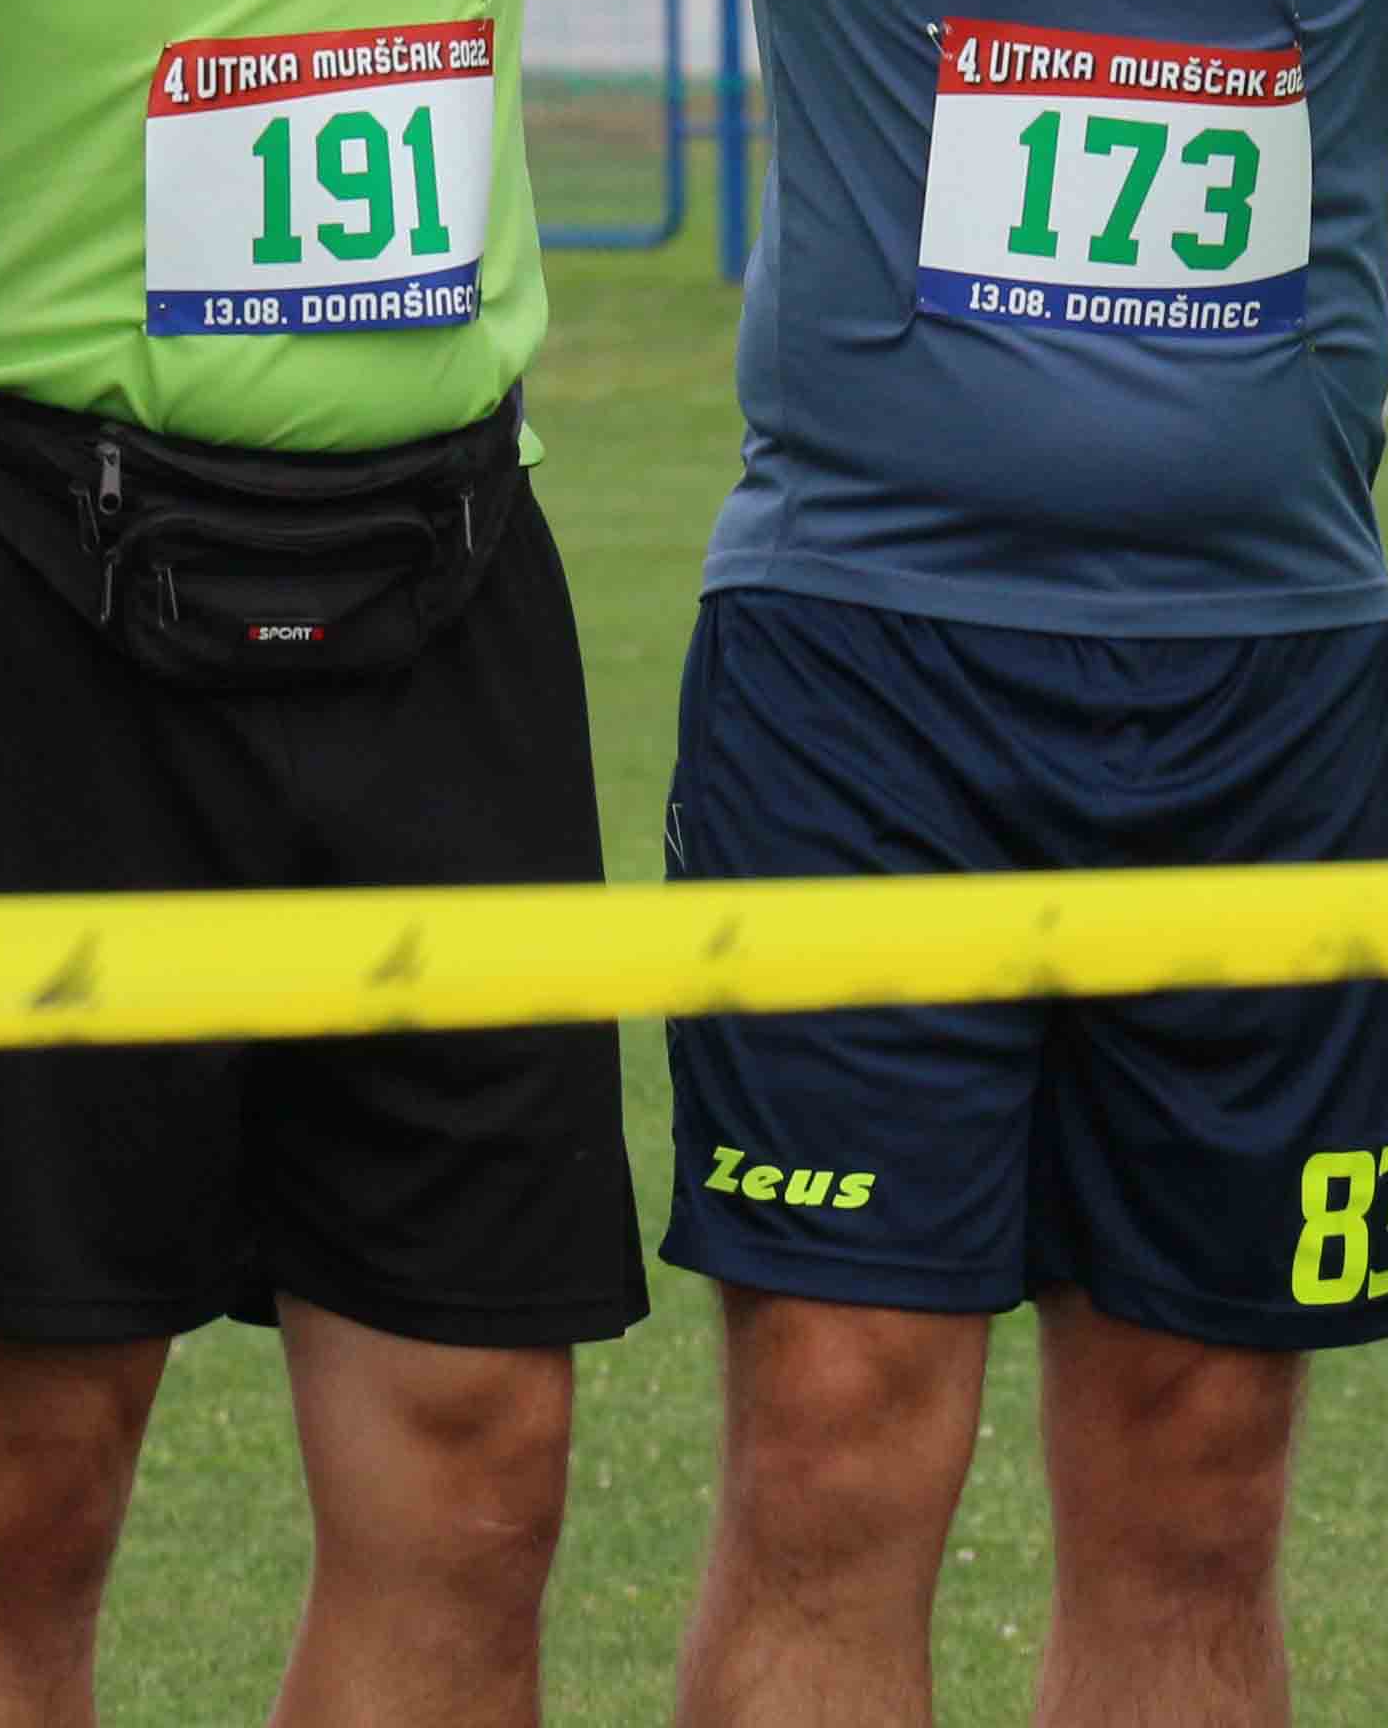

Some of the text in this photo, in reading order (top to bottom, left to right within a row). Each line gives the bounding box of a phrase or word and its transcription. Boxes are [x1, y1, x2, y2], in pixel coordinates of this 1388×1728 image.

[163, 37, 490, 103] 4. UTRKA MURŠČAK 2022.
[957, 37, 981, 83] 4.
[989, 40, 1094, 82] UTRKA
[1110, 56, 1267, 97] MURŠČAK
[252, 105, 451, 264] 191
[1008, 110, 1261, 272] 173
[204, 298, 288, 325] 13.08.
[970, 282, 1261, 329] 13.08. DOMAŠINEC
[704, 1146, 875, 1209] Zeus
